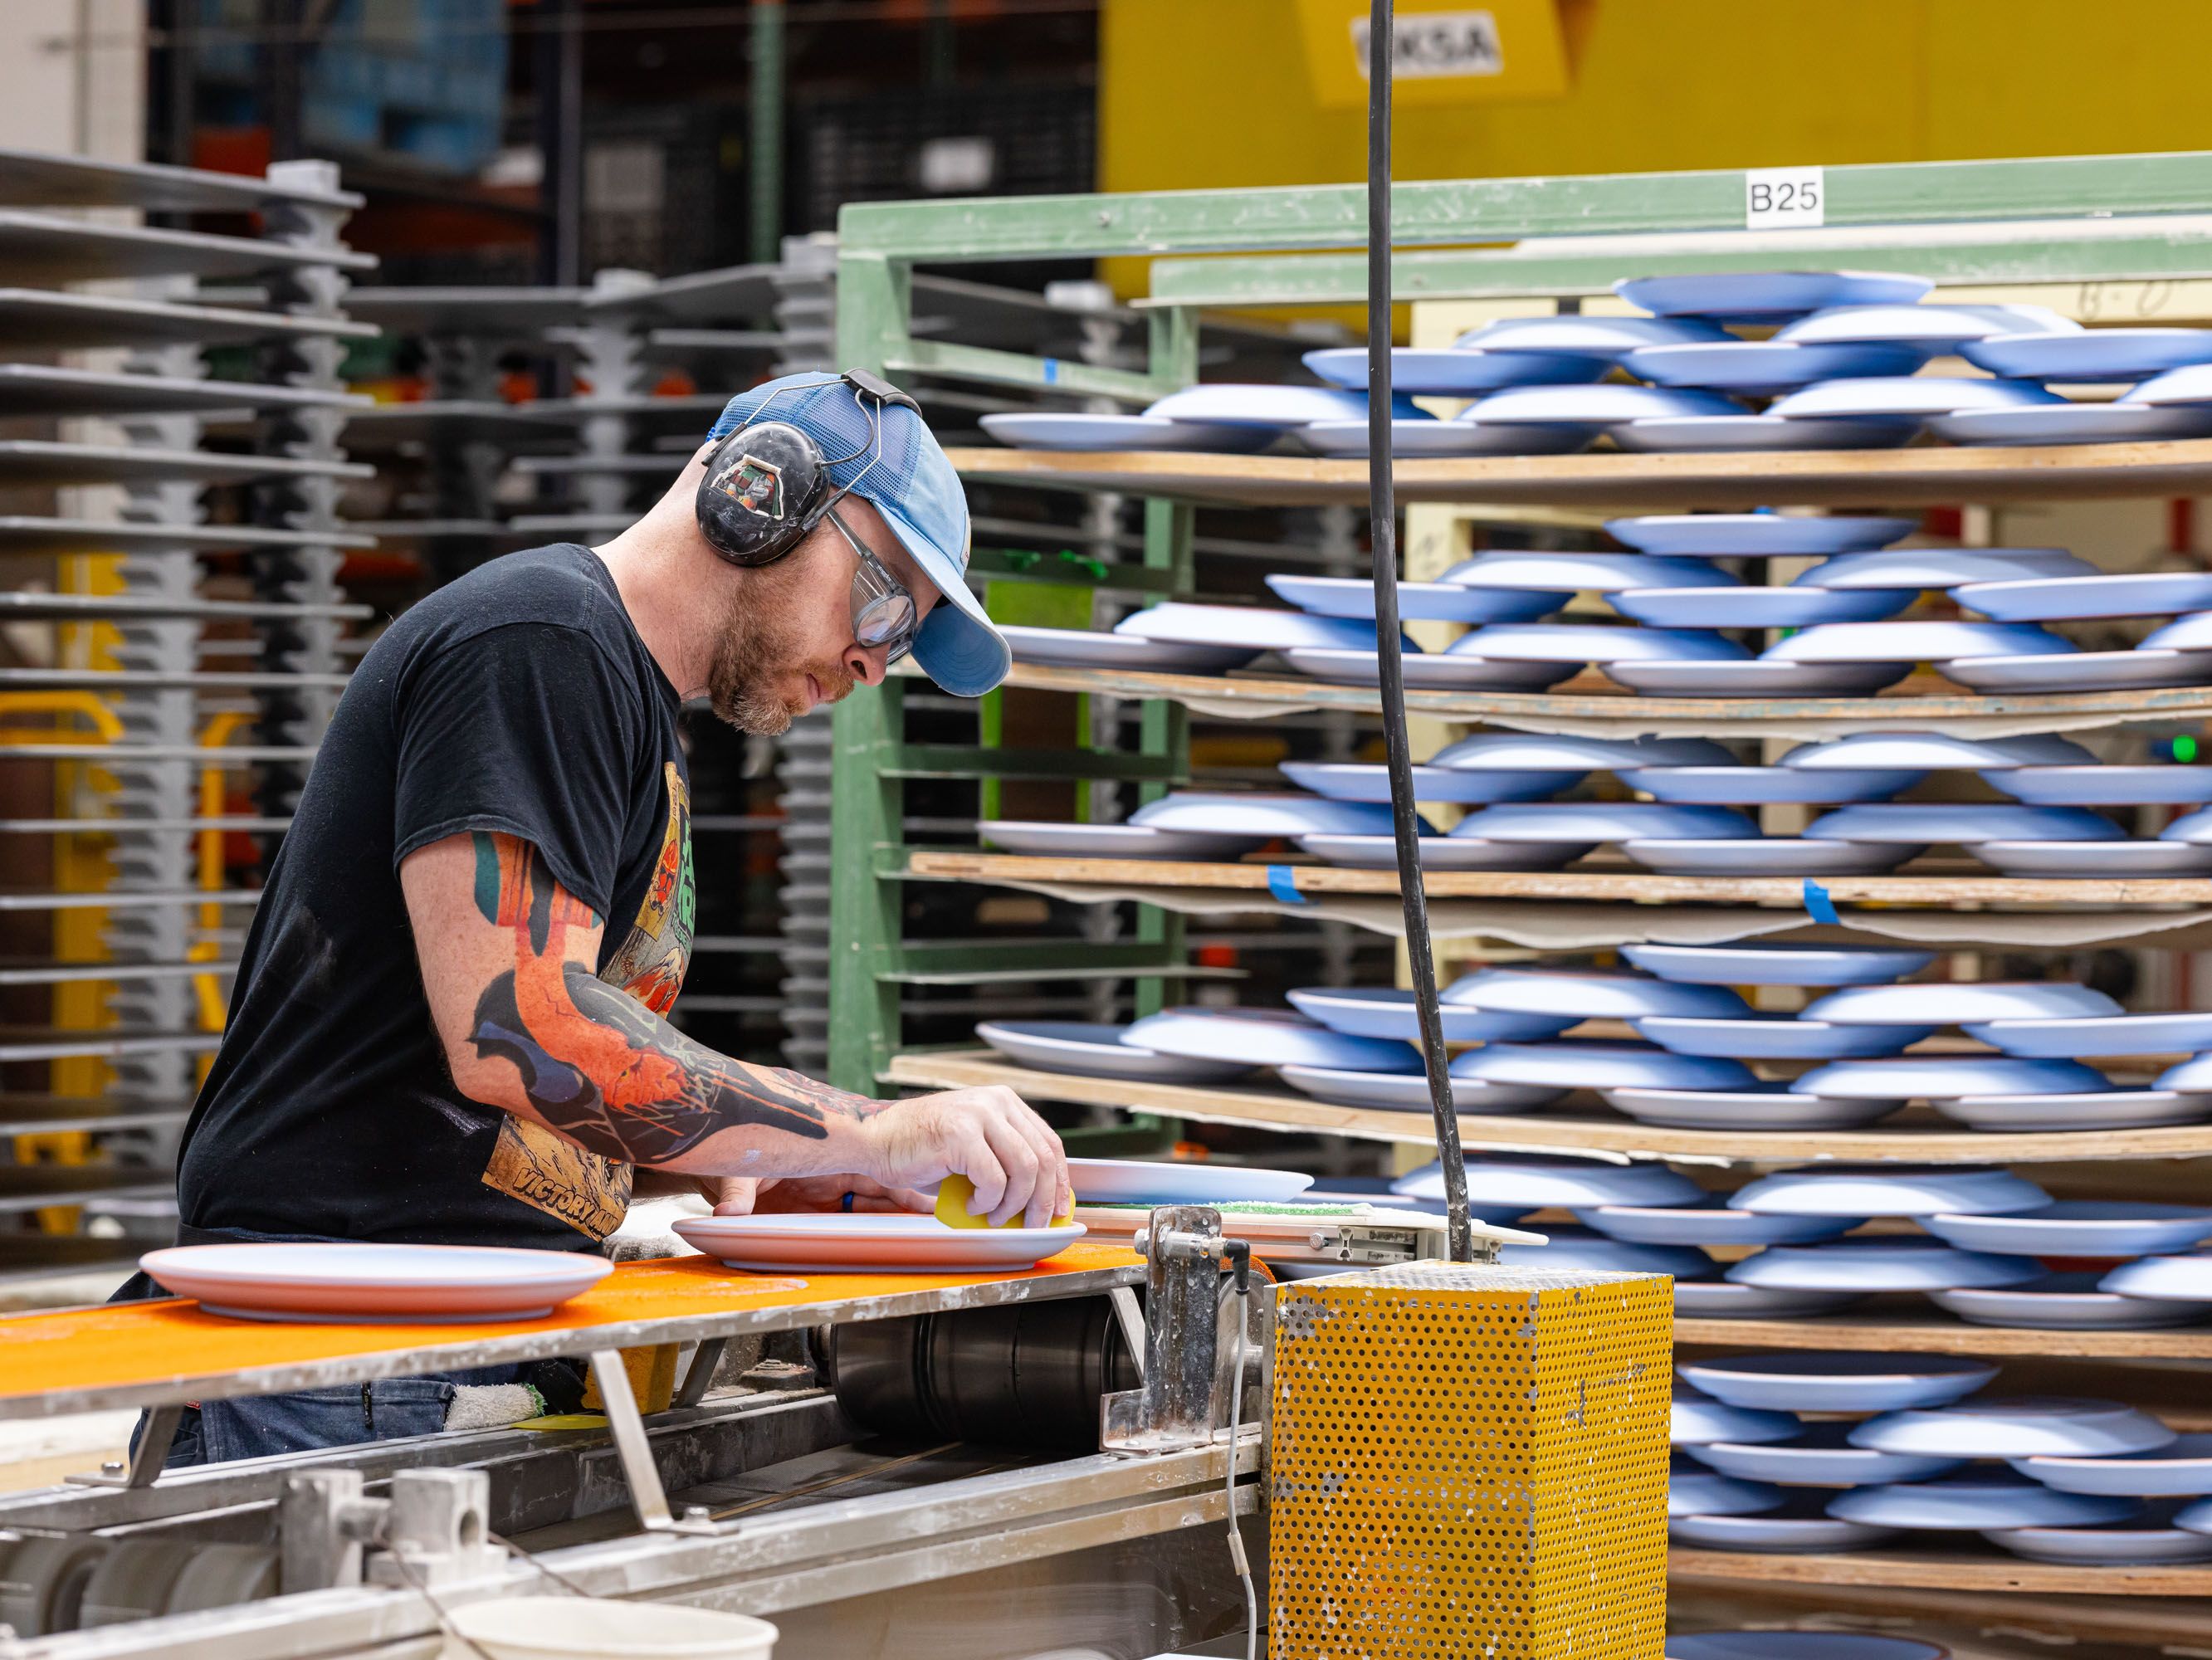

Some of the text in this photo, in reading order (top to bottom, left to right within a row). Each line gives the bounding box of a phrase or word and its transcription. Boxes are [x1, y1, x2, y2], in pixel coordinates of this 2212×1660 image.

[1751, 182, 1817, 212] B25
[512, 1167, 618, 1237] VICTORY AND
